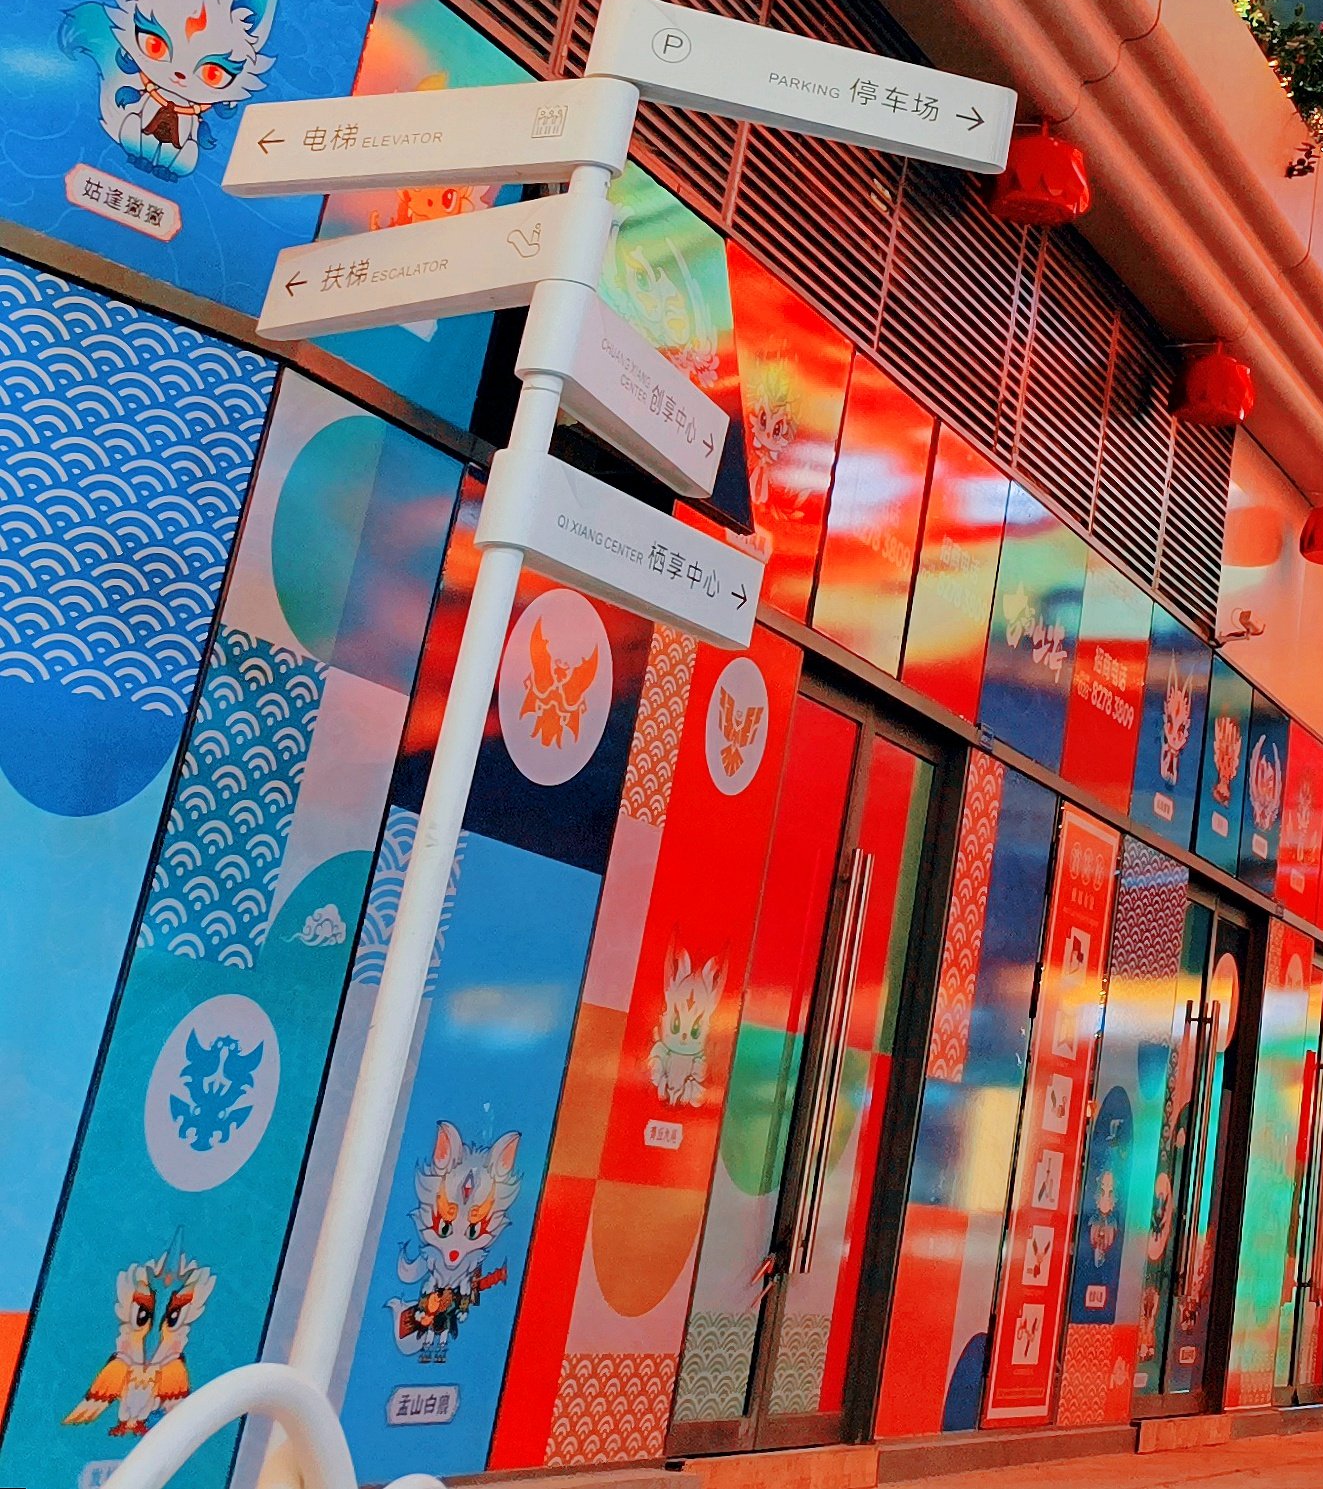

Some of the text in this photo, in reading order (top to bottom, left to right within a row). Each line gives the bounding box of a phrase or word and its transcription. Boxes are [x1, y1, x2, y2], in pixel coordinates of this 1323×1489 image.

[768, 71, 841, 100] PARKING
[849, 77, 940, 123] 停车场
[303, 123, 359, 152] 电梯
[361, 131, 443, 149] ELEVATOR
[320, 258, 371, 293] 扶梯
[370, 259, 449, 284] ESCALATOR
[649, 384, 697, 444] 创享中心
[557, 514, 644, 565] QI XIANG CENTER
[648, 541, 720, 598] 栖享中心
